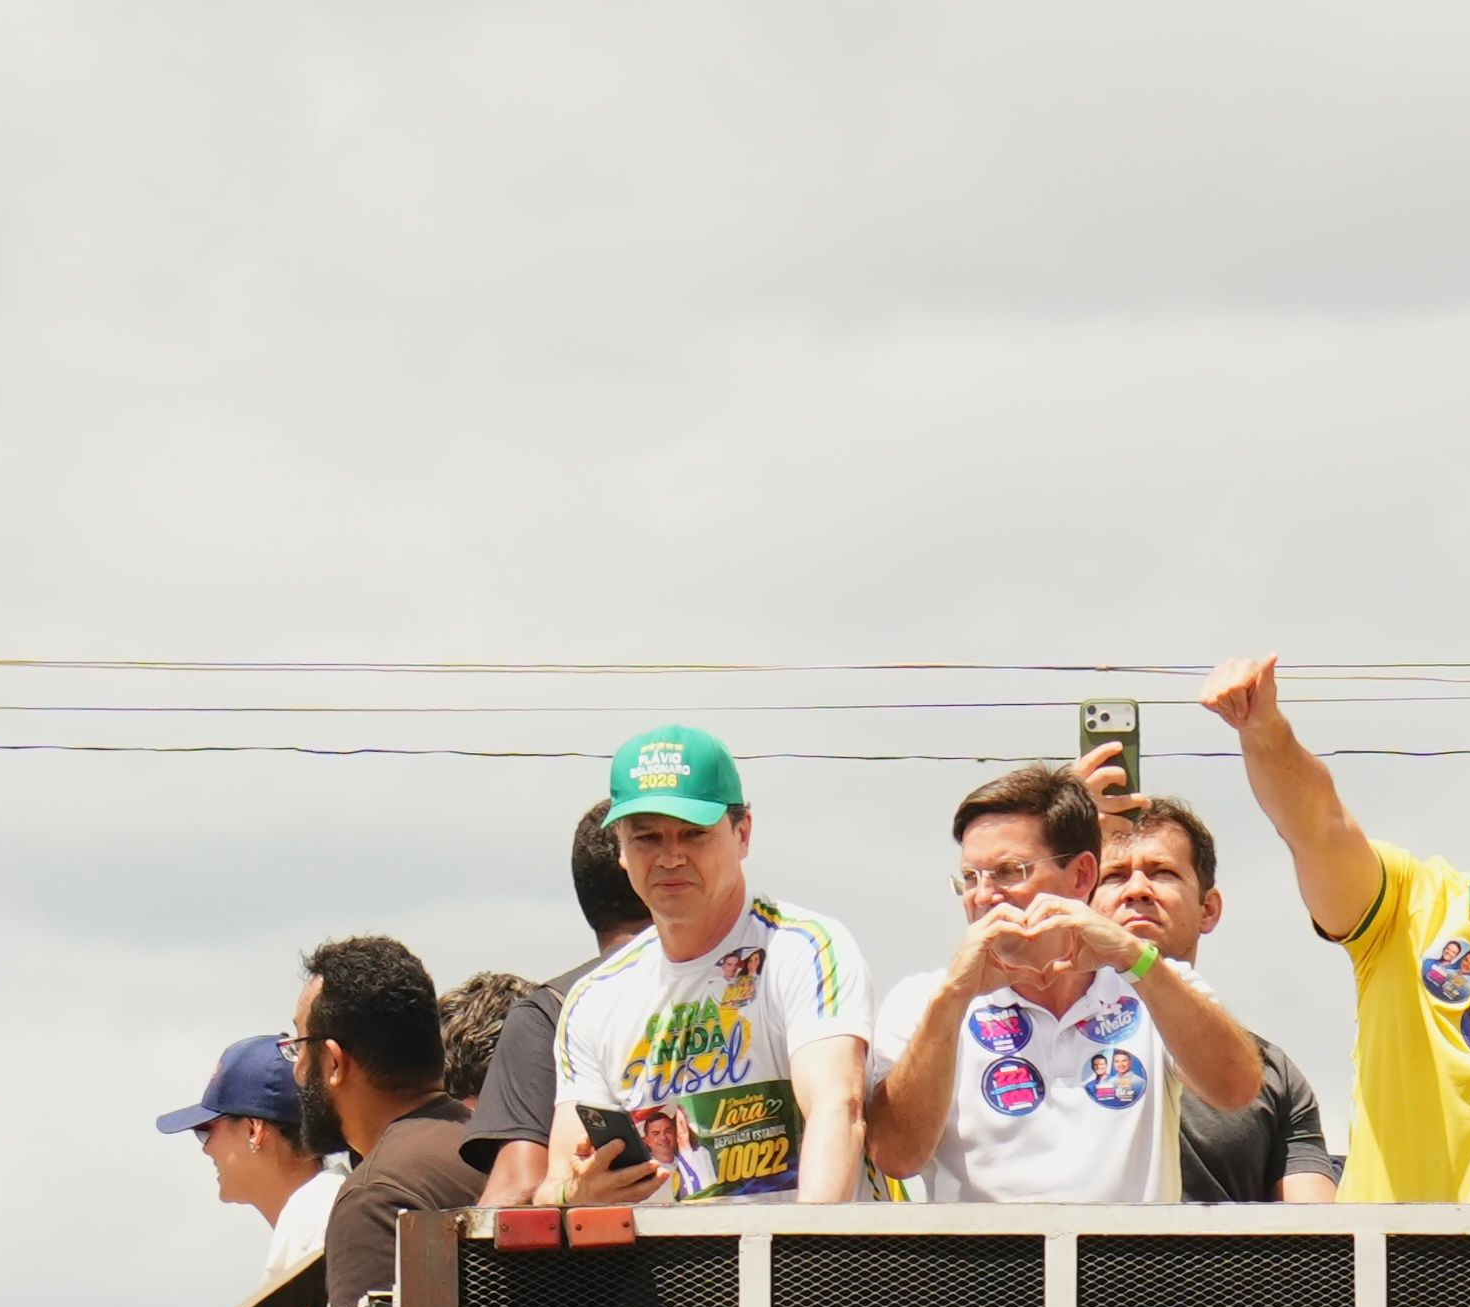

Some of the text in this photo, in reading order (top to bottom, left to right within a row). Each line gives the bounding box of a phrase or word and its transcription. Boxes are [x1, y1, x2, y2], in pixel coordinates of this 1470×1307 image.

[639, 773, 677, 790] 2026
[711, 1098, 768, 1135] Lara
[717, 1136, 789, 1184] 10022
